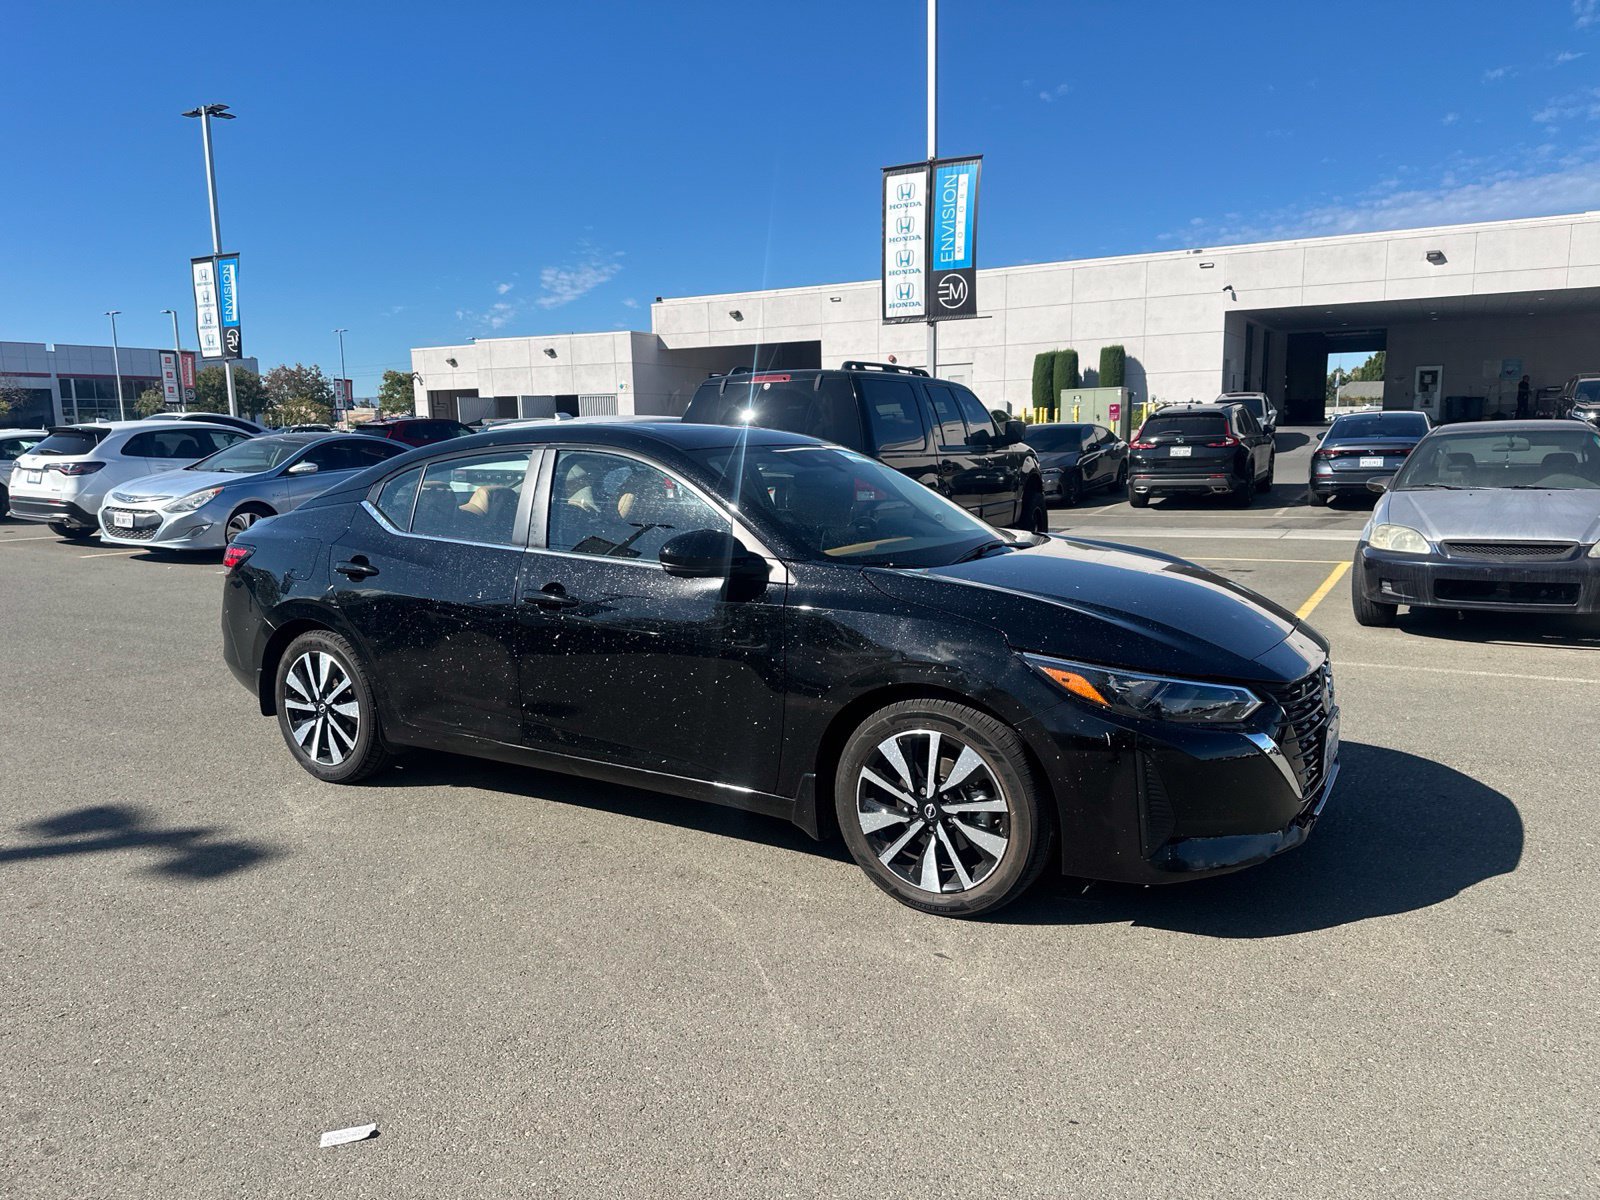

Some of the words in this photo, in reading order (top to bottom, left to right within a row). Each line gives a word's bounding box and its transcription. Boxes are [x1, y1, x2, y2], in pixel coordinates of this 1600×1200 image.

[889, 201, 922, 210] HONDA
[940, 174, 957, 263] ENVISION
[889, 235, 922, 243] HONDA
[889, 268, 922, 276] HONDA
[222, 264, 233, 322] ENVISION
[889, 301, 922, 309] HONDA
